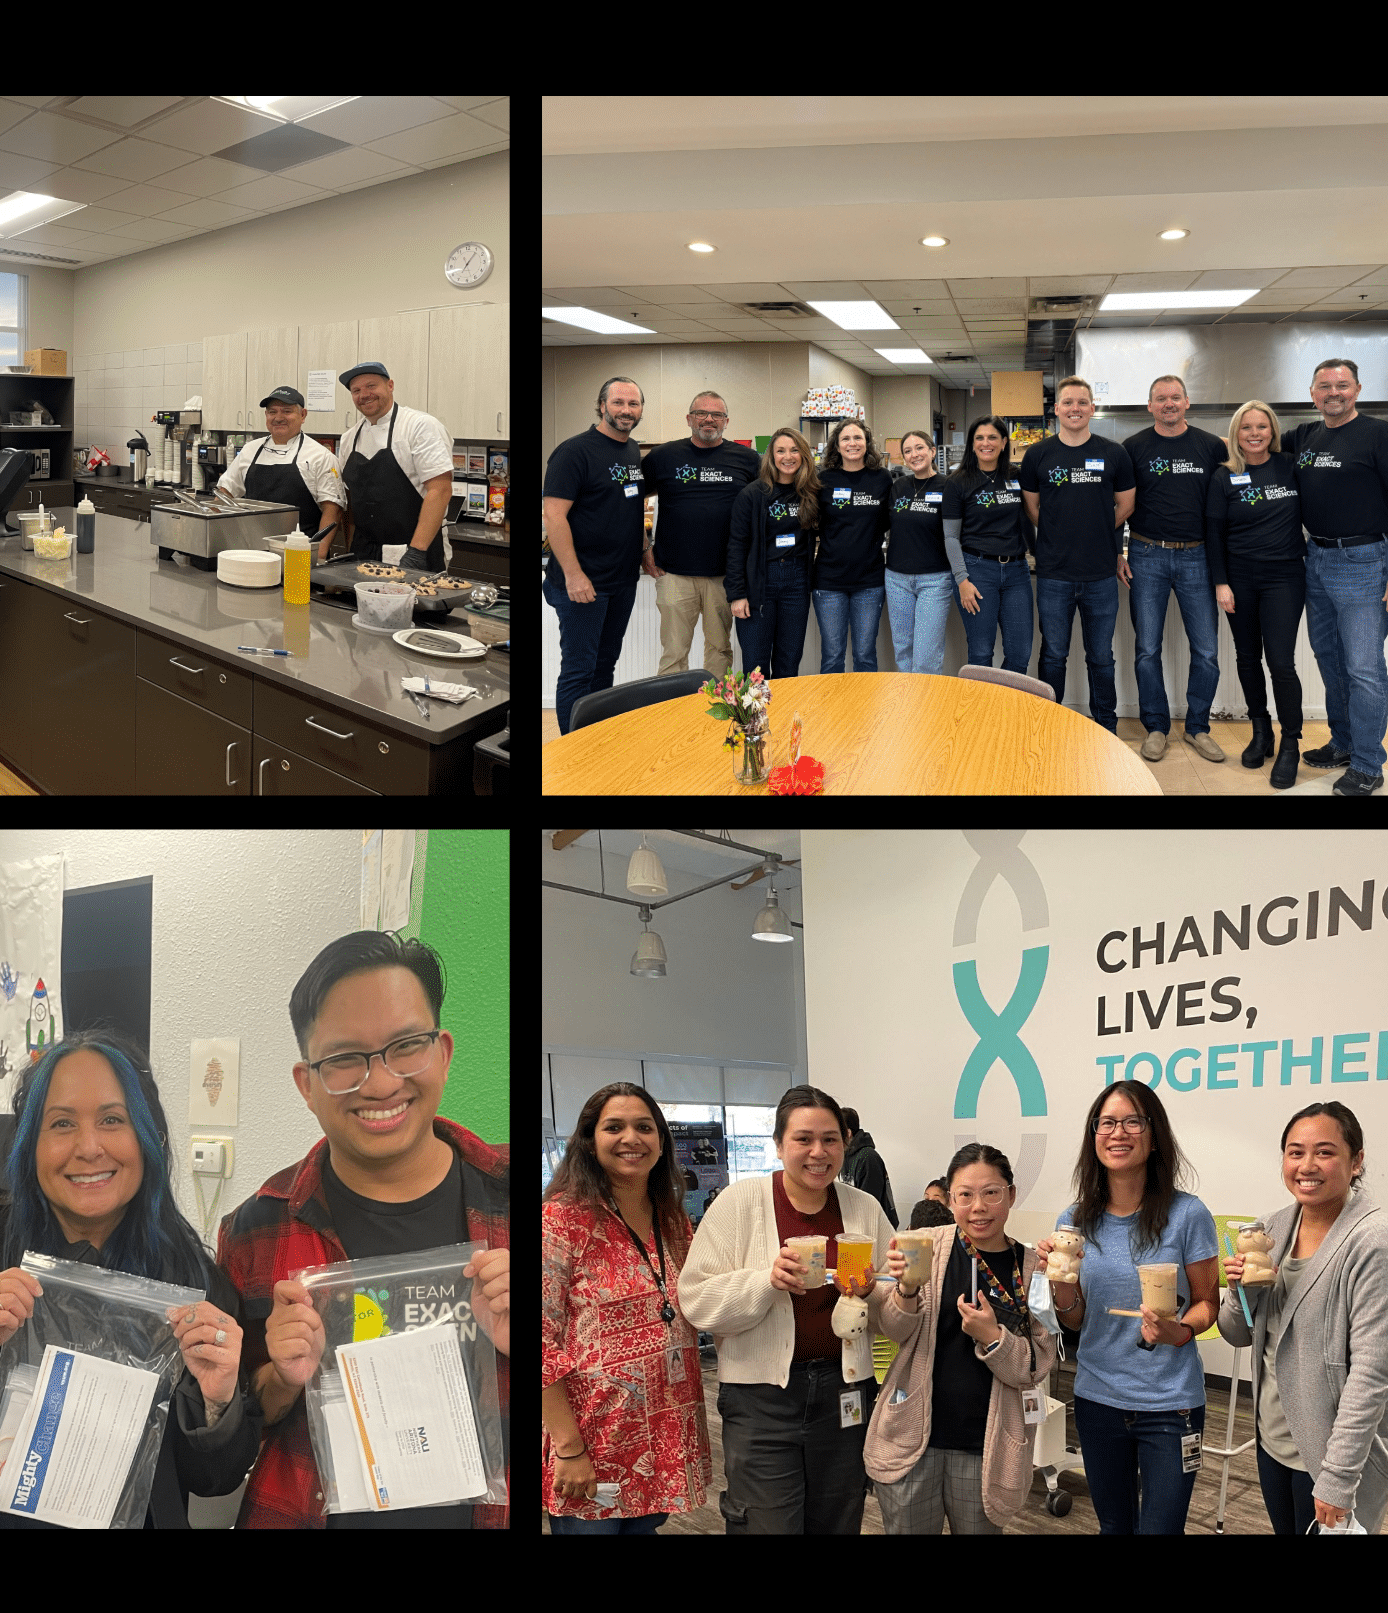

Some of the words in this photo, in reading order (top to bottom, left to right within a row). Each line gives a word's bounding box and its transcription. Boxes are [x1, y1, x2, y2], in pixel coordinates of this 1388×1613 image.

[1264, 486, 1287, 496] EXACT
[1266, 490, 1298, 500] SCIENCES
[1096, 879, 1388, 973] CHANGIN
[1096, 976, 1258, 1036] LIVES,
[1096, 1031, 1388, 1092] TOGETHE
[405, 1284, 455, 1299] TEAM
[405, 1301, 472, 1323] EXAC
[14, 1450, 43, 1507] Mighty
[35, 1391, 63, 1454] Change
[417, 1426, 430, 1452] NAU
